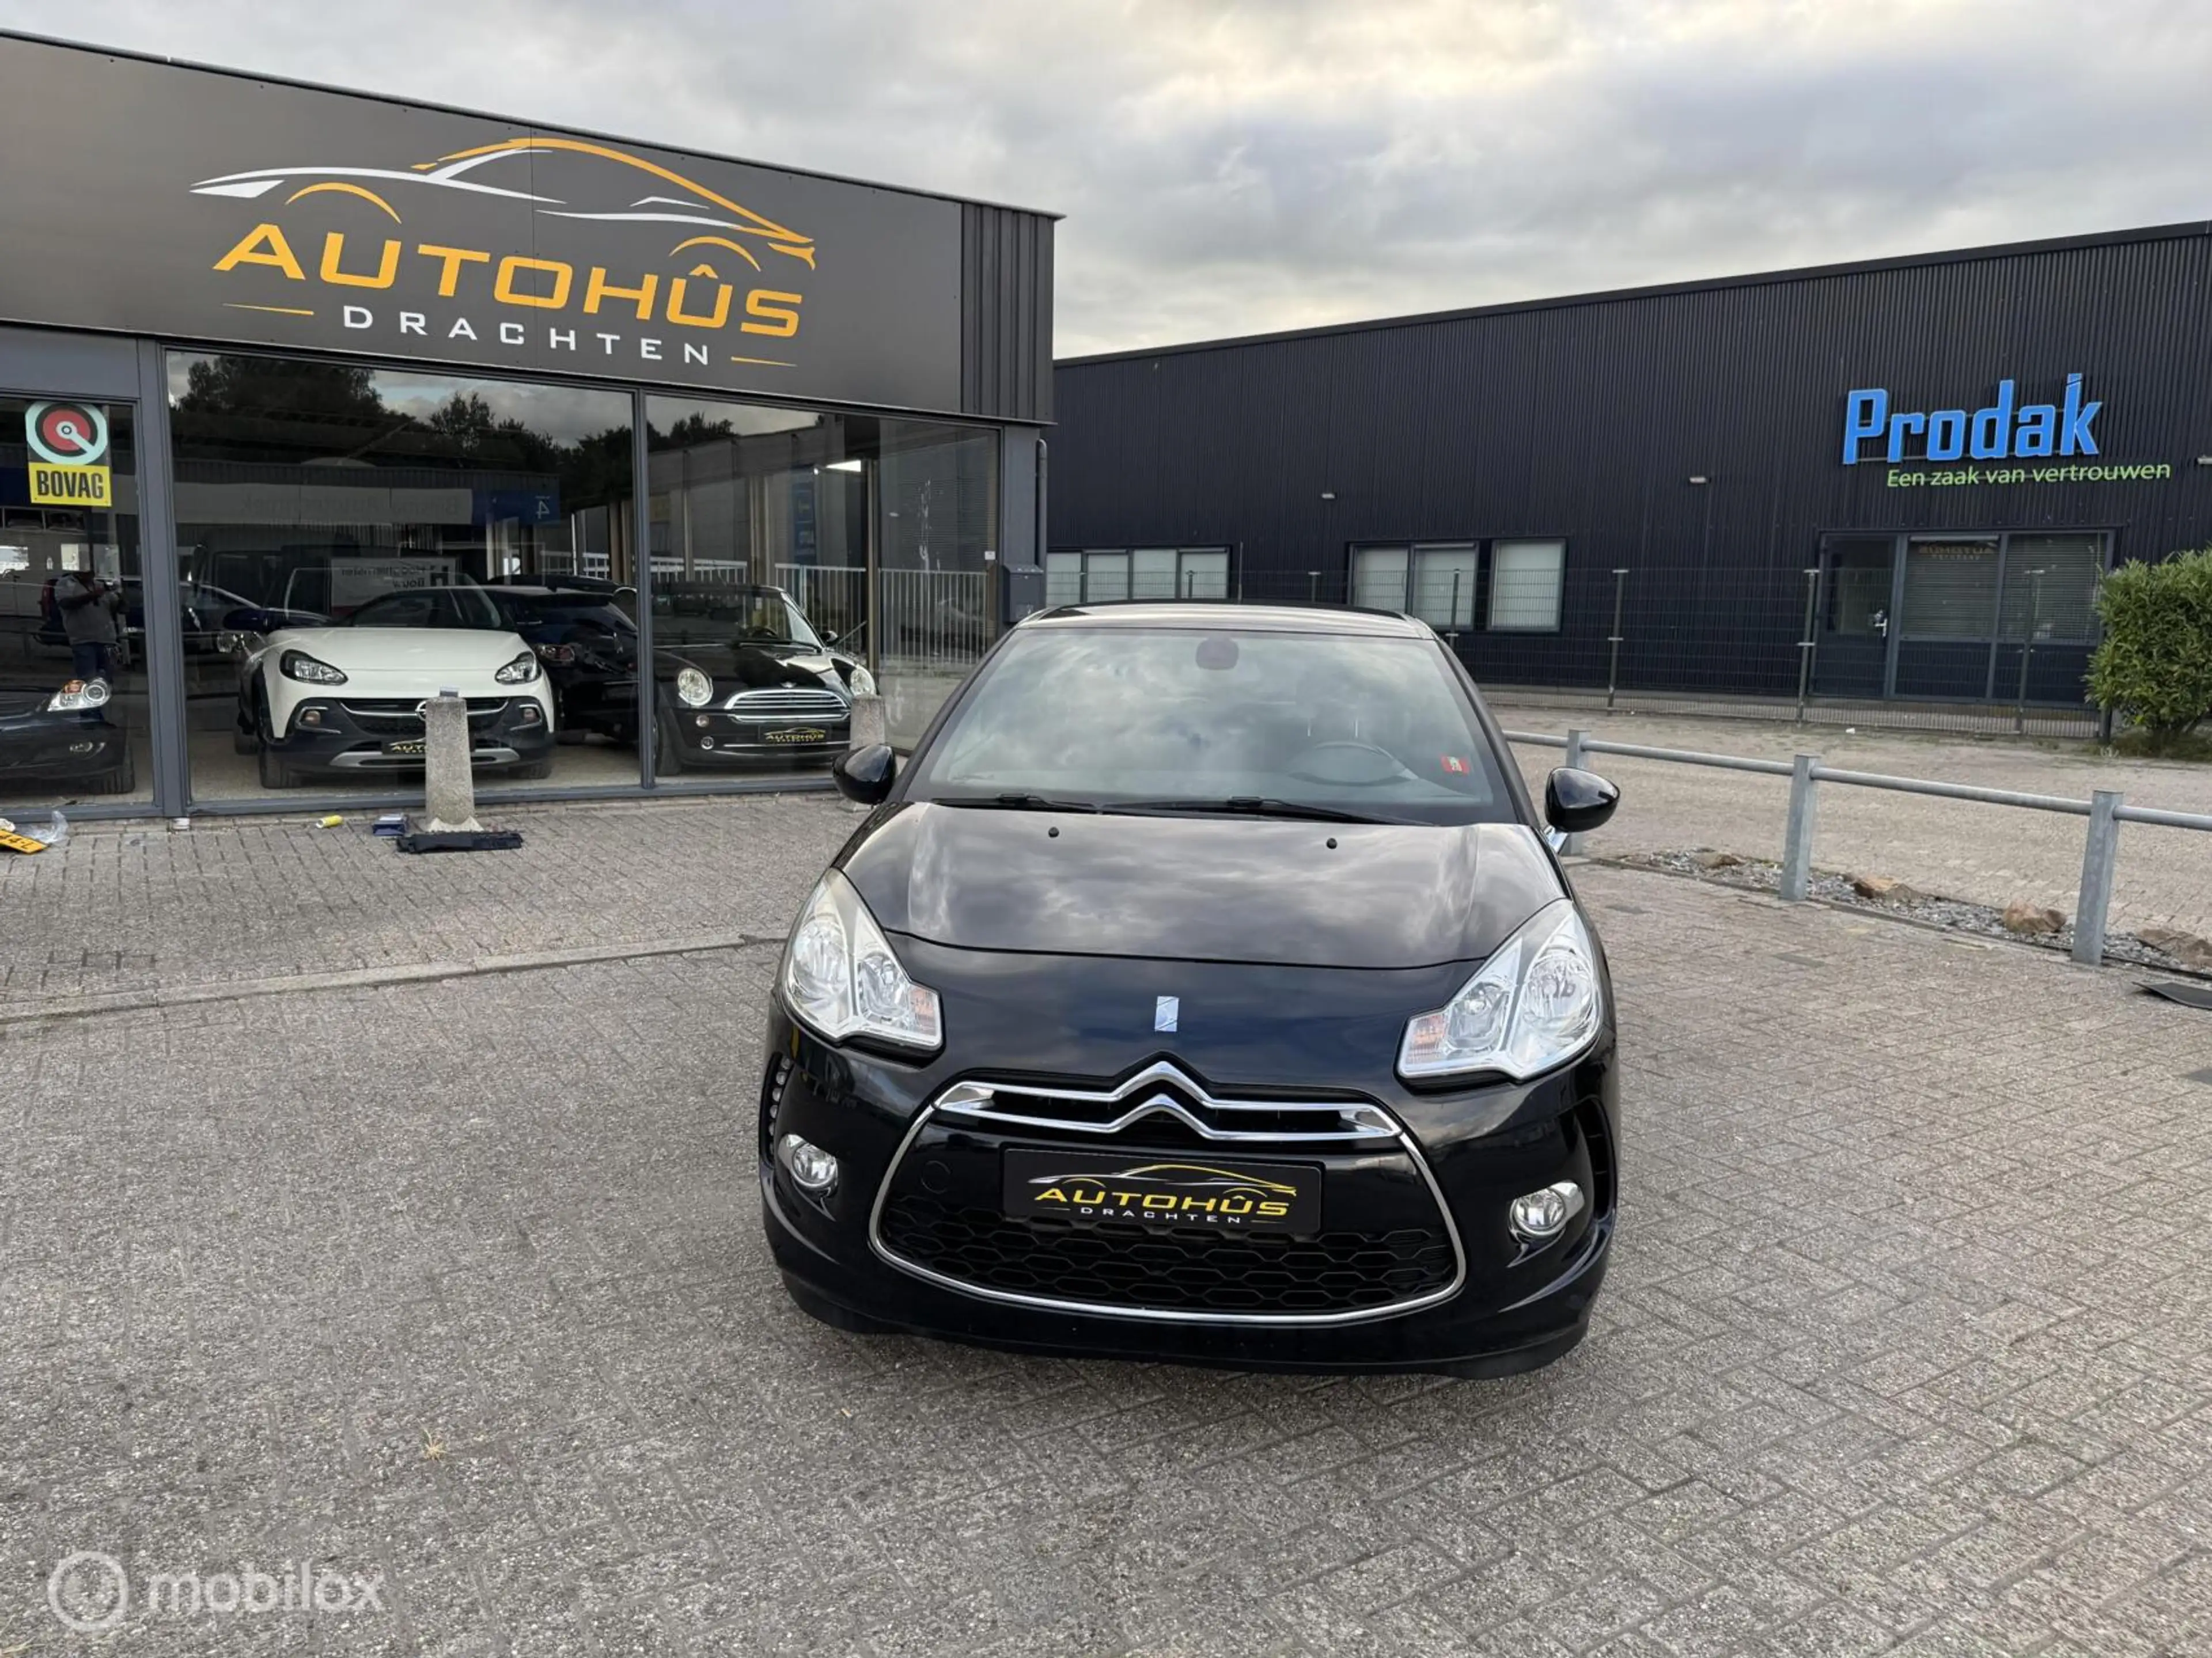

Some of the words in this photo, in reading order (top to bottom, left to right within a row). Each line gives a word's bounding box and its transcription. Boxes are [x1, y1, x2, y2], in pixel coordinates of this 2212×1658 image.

[213, 223, 803, 337] AUTOHÛS
[343, 305, 709, 366] DRACHTEN
[1843, 373, 2103, 465] Prodak
[36, 470, 104, 499] BOVAG
[1887, 469, 1925, 487] Een
[1930, 466, 1979, 486] zaak
[1986, 468, 2025, 484] van
[2032, 463, 2171, 483] vertrouwen
[1035, 1187, 1290, 1217] AUTOHÛS
[1080, 1206, 1241, 1224] DRACHTEN
